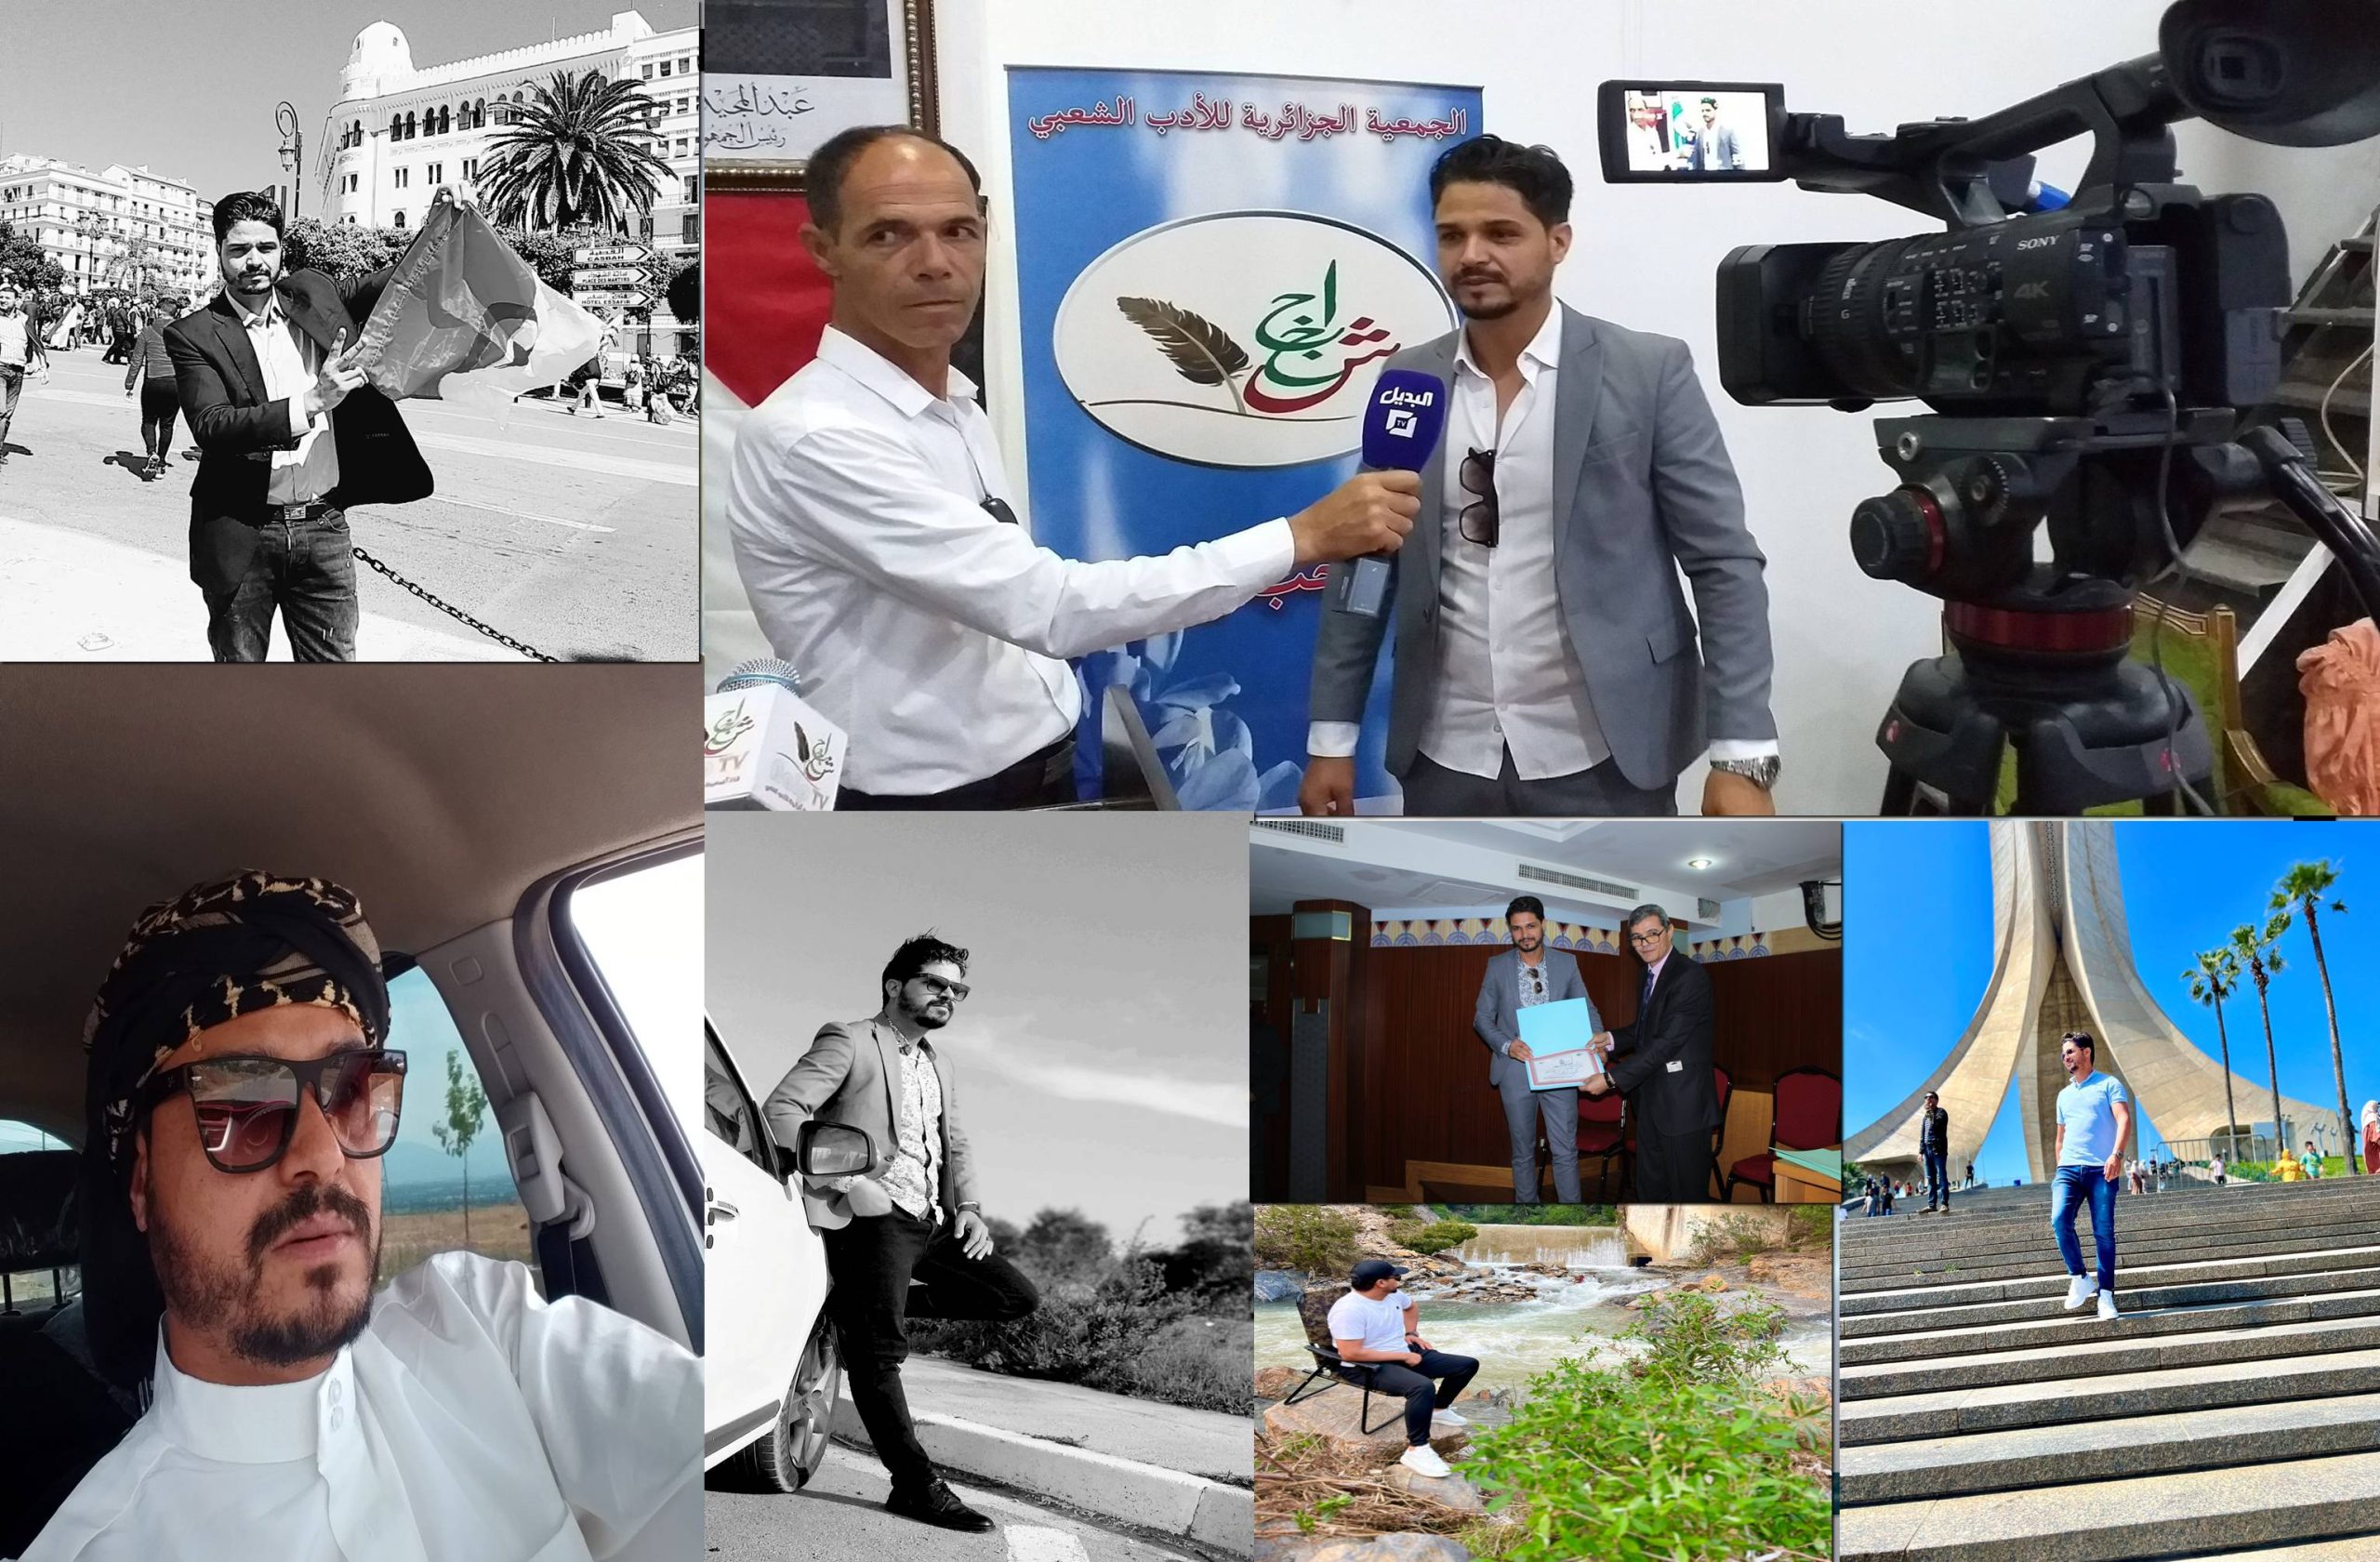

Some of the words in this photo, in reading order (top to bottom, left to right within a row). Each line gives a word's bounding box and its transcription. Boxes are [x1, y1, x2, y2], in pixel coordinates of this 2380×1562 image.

[1027, 95, 1136, 139] الشعبي
[1144, 90, 1232, 135] للأدب
[1241, 101, 1357, 140] الجزائرية
[1366, 106, 1468, 141] الجمعية
[704, 122, 754, 148] الجمهو
[2016, 235, 2061, 251] SONY
[2013, 280, 2050, 299] 4K
[1840, 309, 1851, 320] G
[1379, 386, 1435, 408] البديل
[1396, 419, 1407, 428] TV
[720, 750, 750, 773] TV
[811, 789, 830, 811] TV
